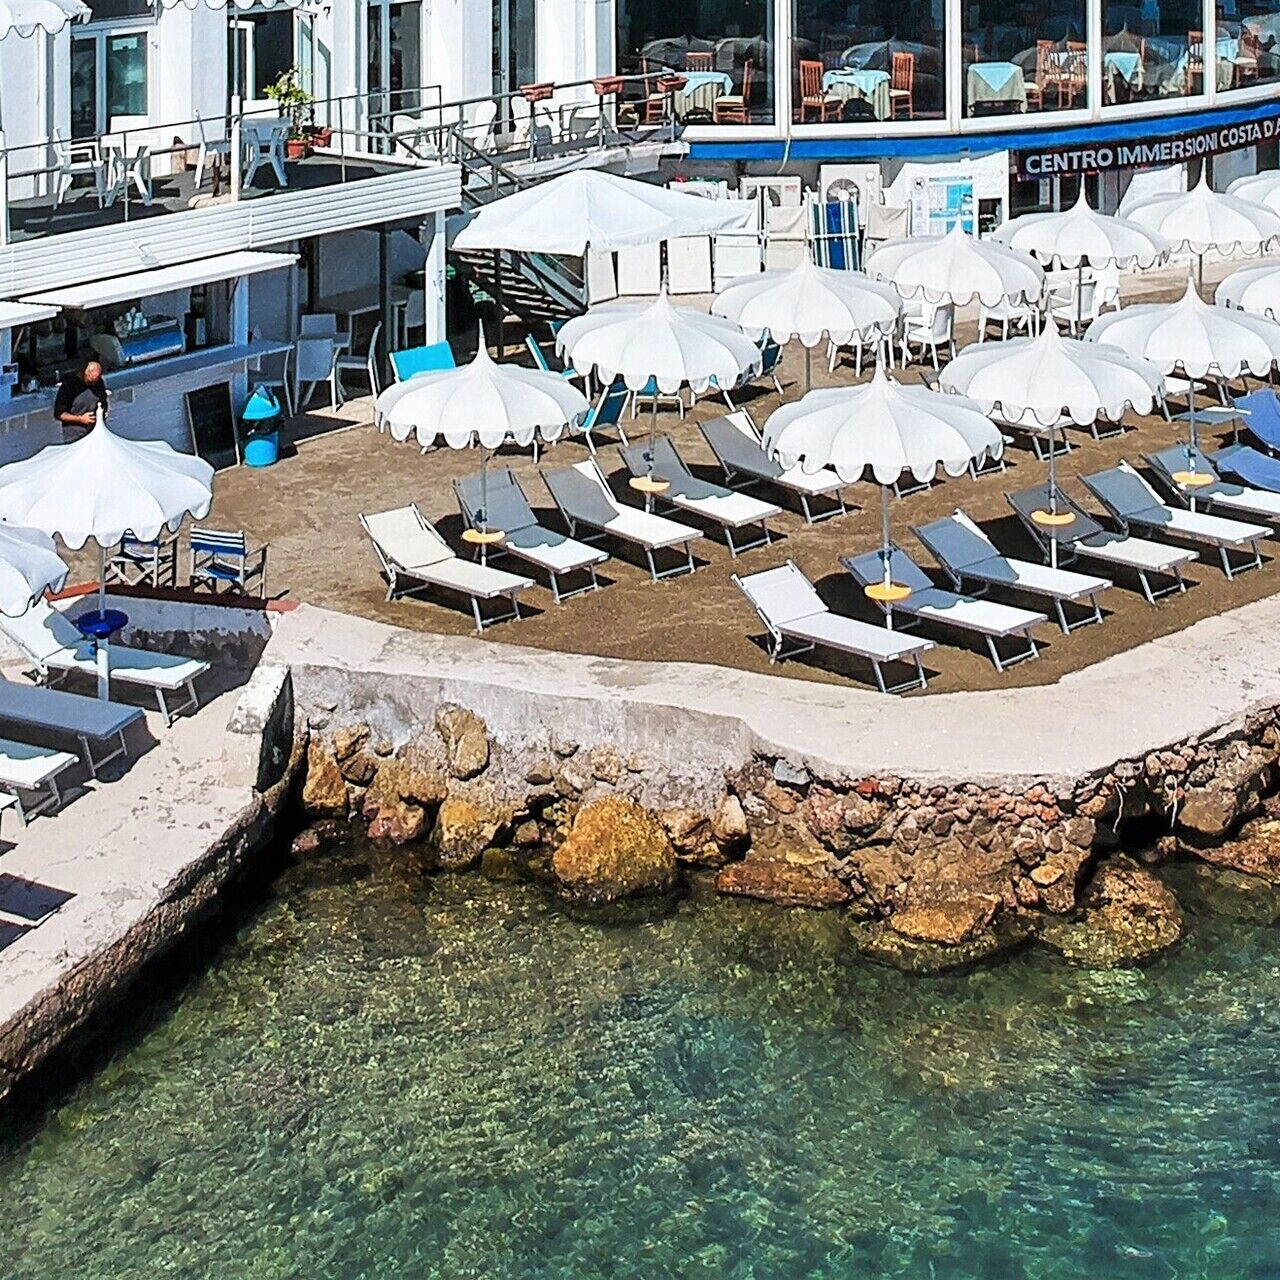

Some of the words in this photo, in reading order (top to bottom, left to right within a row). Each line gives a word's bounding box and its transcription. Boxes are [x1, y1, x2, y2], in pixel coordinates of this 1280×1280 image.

[1026, 148, 1113, 173] CENTRO
[1117, 132, 1218, 165] IMMERSIONI
[1220, 124, 1261, 148] COSTA
